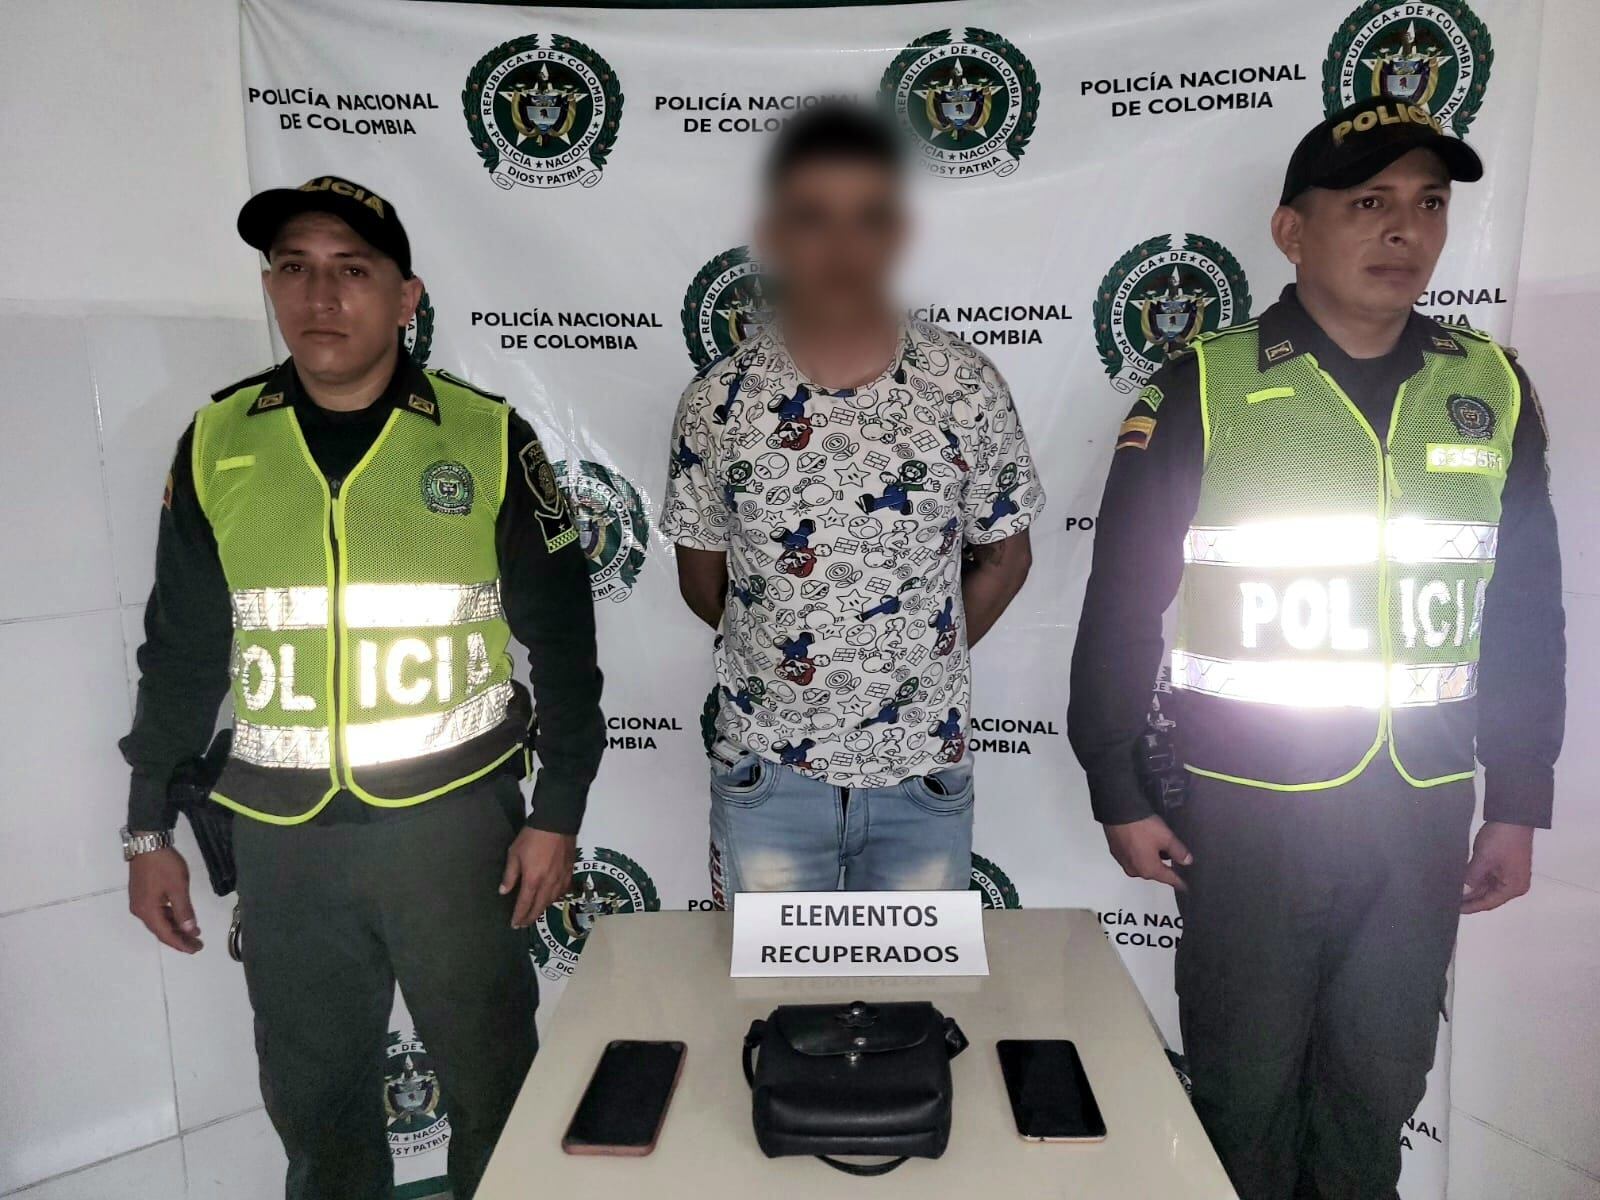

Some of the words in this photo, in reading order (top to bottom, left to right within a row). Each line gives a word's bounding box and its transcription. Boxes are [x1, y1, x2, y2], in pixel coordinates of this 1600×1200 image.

[1405, 5, 1424, 16] DE
[1436, 12, 1471, 79] COLOMBIA
[537, 50, 555, 60] DE
[567, 58, 604, 117] COLOMBIA
[950, 45, 968, 55] DE
[981, 51, 1020, 108] COLOMBIA
[1080, 71, 1174, 97] POLICÍA
[1179, 63, 1307, 91] NACIONAL
[248, 87, 331, 110] POLICÍA
[337, 92, 439, 111] NACIONAL
[655, 92, 742, 111] POLICÍA
[1111, 98, 1141, 118] DE
[1148, 91, 1274, 116] COLOMBIA
[280, 113, 302, 130] DE
[306, 113, 416, 136] COLOMBIA
[684, 118, 712, 133] DE
[718, 117, 788, 133] COLO
[545, 129, 598, 169] NACIONAL
[959, 121, 1014, 161] NACIONAL
[547, 165, 586, 185] PATRIA
[959, 156, 1002, 175] PATRIA
[301, 177, 385, 219] LICIA
[1170, 252, 1187, 262] DE
[1198, 258, 1231, 322] COLOMBIA
[1414, 288, 1507, 307] CIONAL
[471, 308, 553, 327] POLICÍA
[558, 312, 663, 328] NACIONAL
[957, 304, 1072, 322] NACIONAL
[500, 334, 528, 349] DE
[533, 334, 638, 350] COLOMBIA
[949, 329, 1043, 346] LOMBIA
[1128, 371, 1149, 386] DIO
[590, 551, 628, 584] CIONAL
[591, 583, 616, 598] TRIA
[607, 716, 683, 731] CIONAL
[970, 717, 1059, 735] ACIONAL
[609, 736, 657, 750] MBIA
[968, 738, 1032, 755] OMBIA
[583, 862, 598, 871] DE
[609, 867, 644, 912] COLOMBI
[971, 871, 1004, 909] COLOM
[780, 904, 939, 928] ELEMENTOS
[760, 945, 960, 964] RECUPERADOS
[401, 1043, 418, 1052] DE
[413, 1132, 450, 1153] PATRIA
